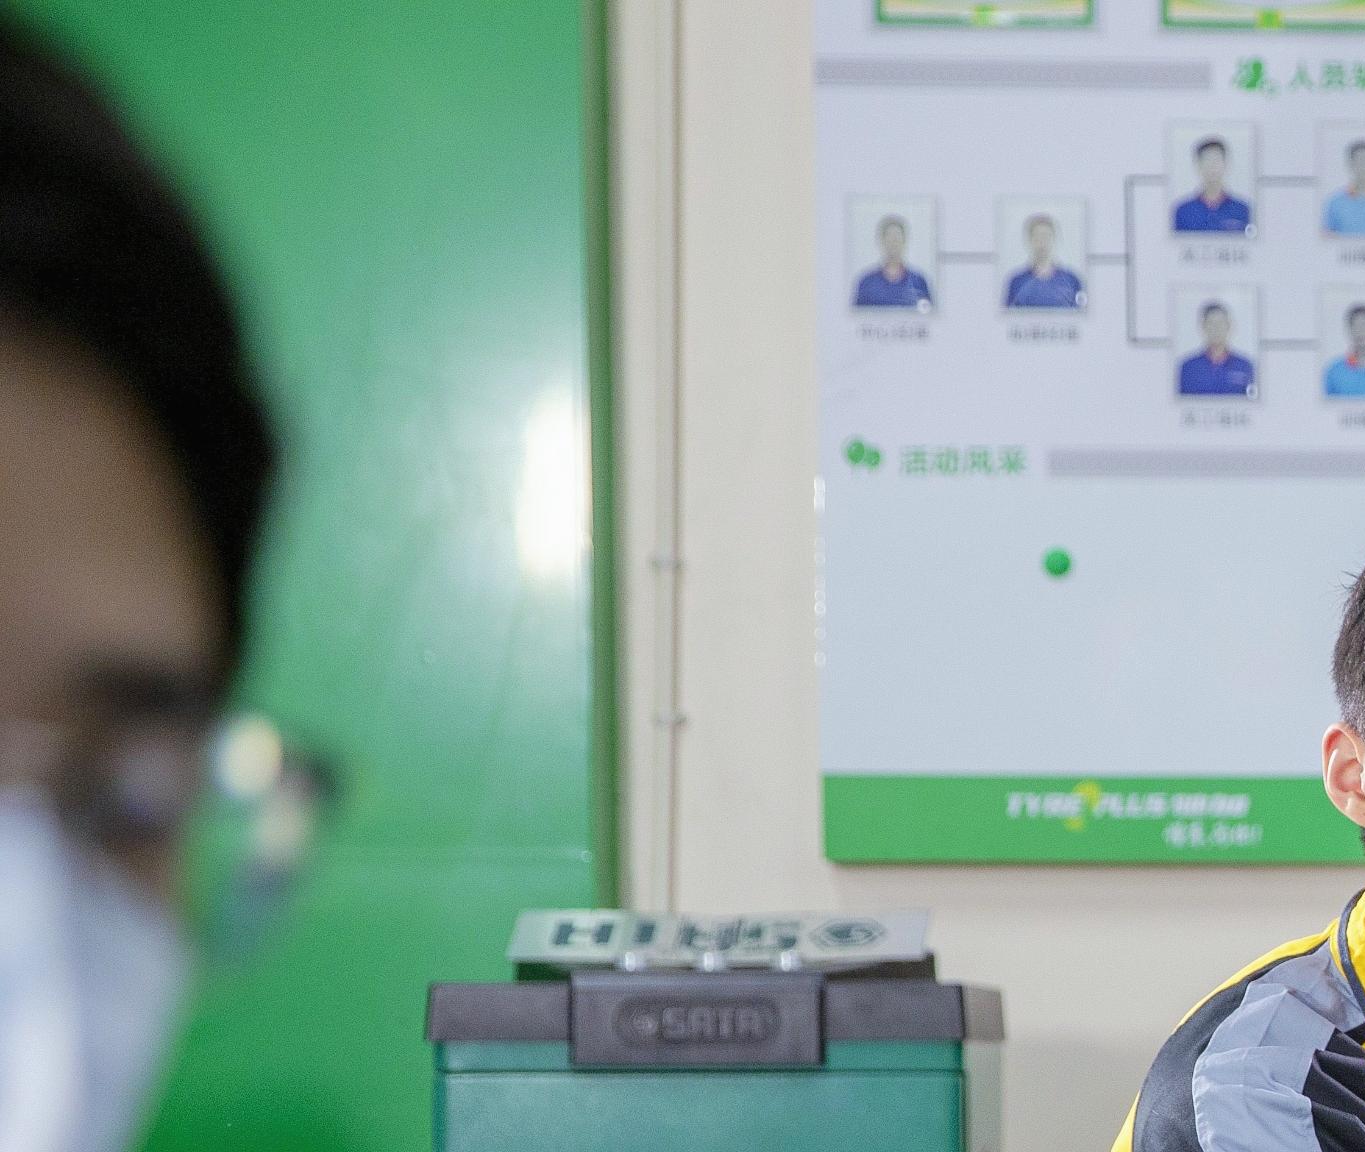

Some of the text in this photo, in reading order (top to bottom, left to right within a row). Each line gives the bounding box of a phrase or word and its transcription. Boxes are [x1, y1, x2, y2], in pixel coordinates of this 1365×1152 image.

[901, 445, 1026, 475] 活动风采
[662, 1005, 769, 1042] SATA
